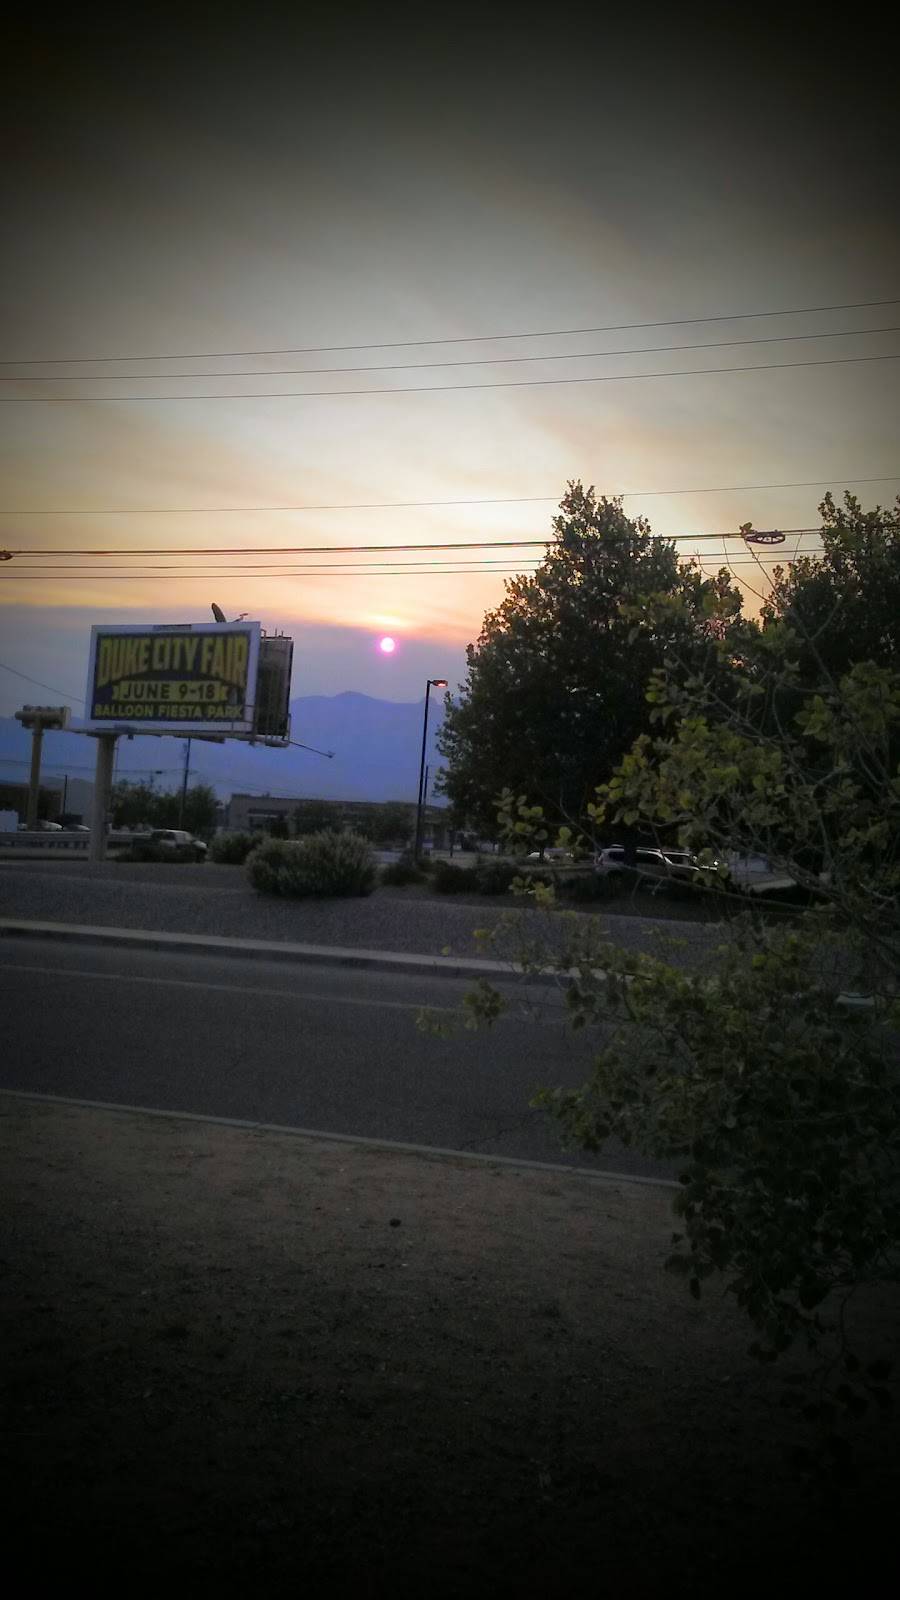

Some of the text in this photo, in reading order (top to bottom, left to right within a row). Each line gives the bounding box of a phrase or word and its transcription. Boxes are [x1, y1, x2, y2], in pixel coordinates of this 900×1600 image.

[97, 634, 247, 688] DUKE CITY FAIR
[123, 683, 216, 700] JUNE 9-18
[95, 704, 243, 718] BALLOON FIESTA PARK
